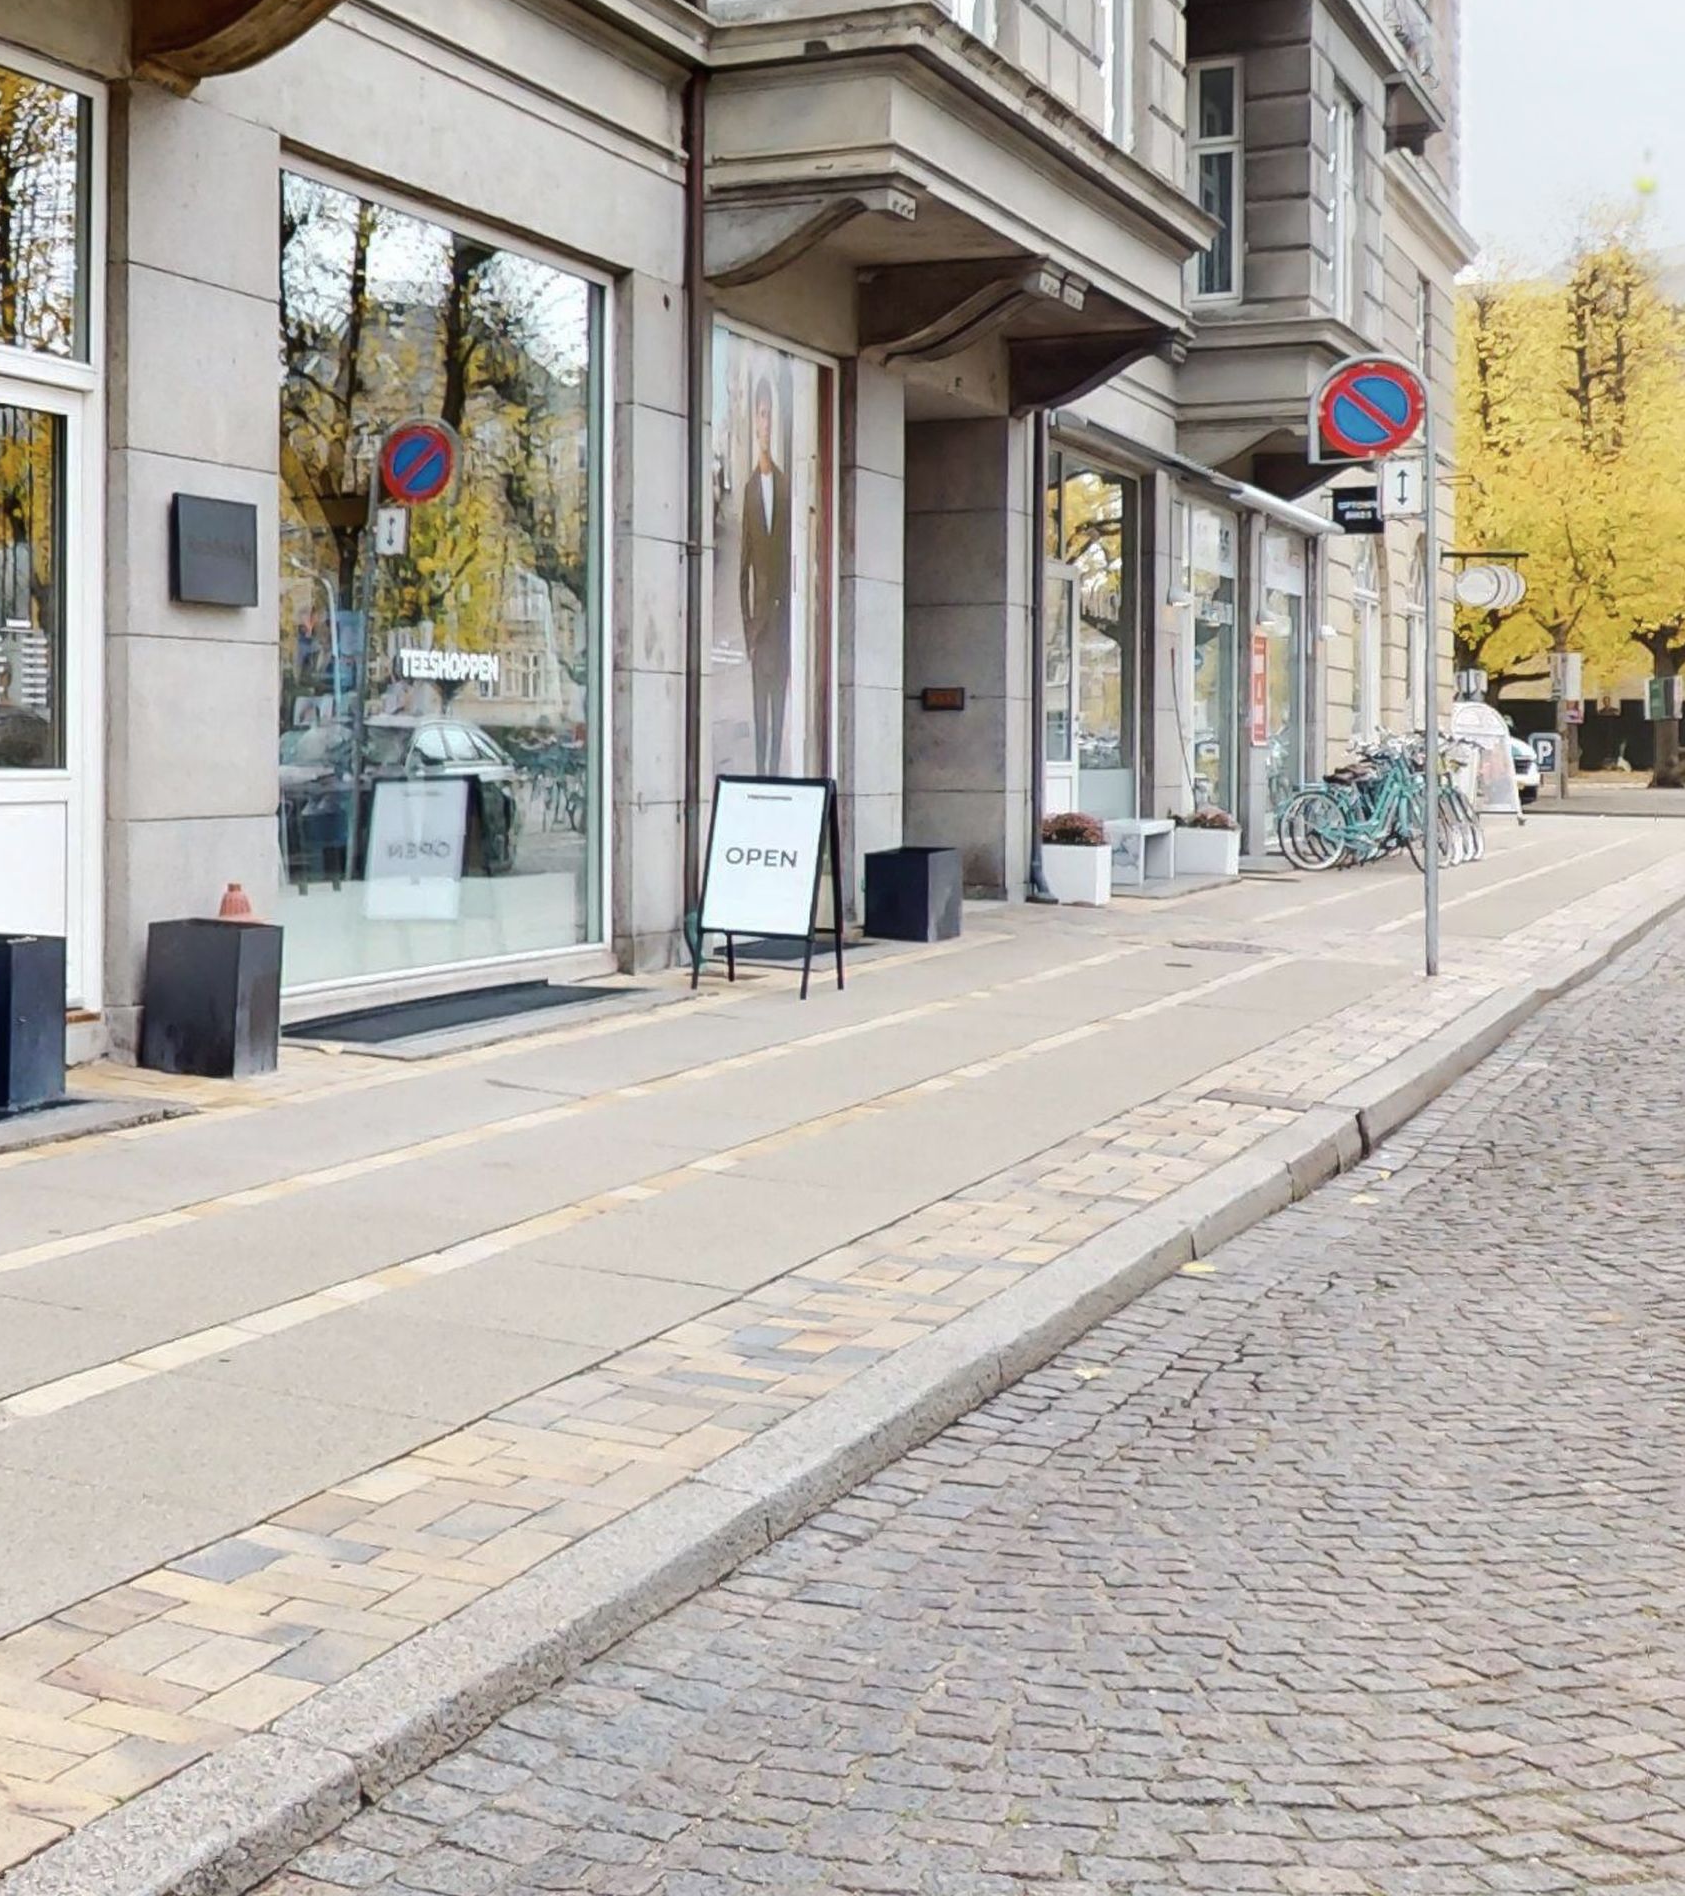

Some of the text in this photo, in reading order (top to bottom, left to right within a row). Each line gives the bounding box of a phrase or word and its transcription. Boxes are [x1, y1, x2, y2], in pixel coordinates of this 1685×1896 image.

[400, 648, 499, 681] TEESHOPPEN
[1537, 740, 1553, 765] P
[725, 847, 798, 868] OPEN
